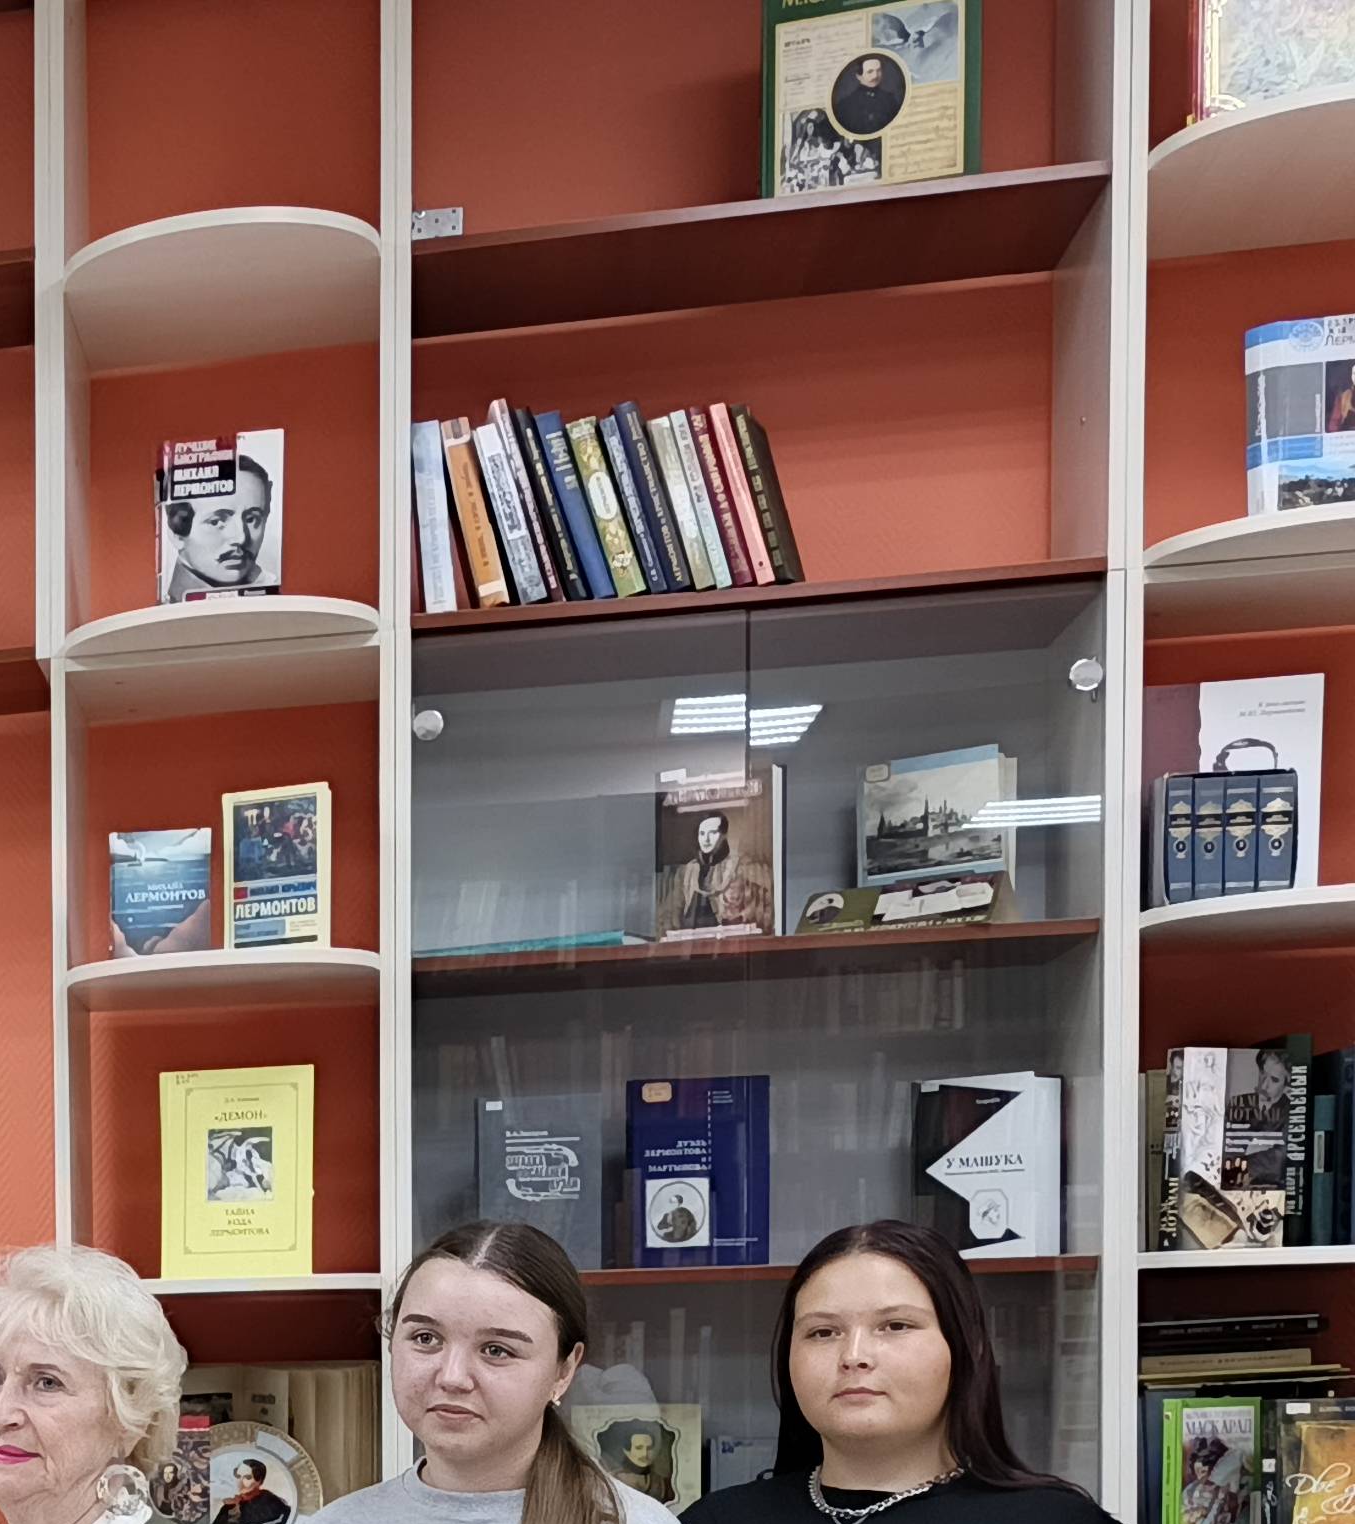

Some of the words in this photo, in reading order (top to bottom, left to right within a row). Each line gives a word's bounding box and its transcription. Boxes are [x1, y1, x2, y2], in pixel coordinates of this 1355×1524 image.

[125, 889, 206, 903] ЛЕРМОНТОВ
[235, 896, 316, 920] ЛЕРМОНТОВ
[946, 1158, 955, 1169] У
[959, 1154, 1023, 1168] МАШУКА
